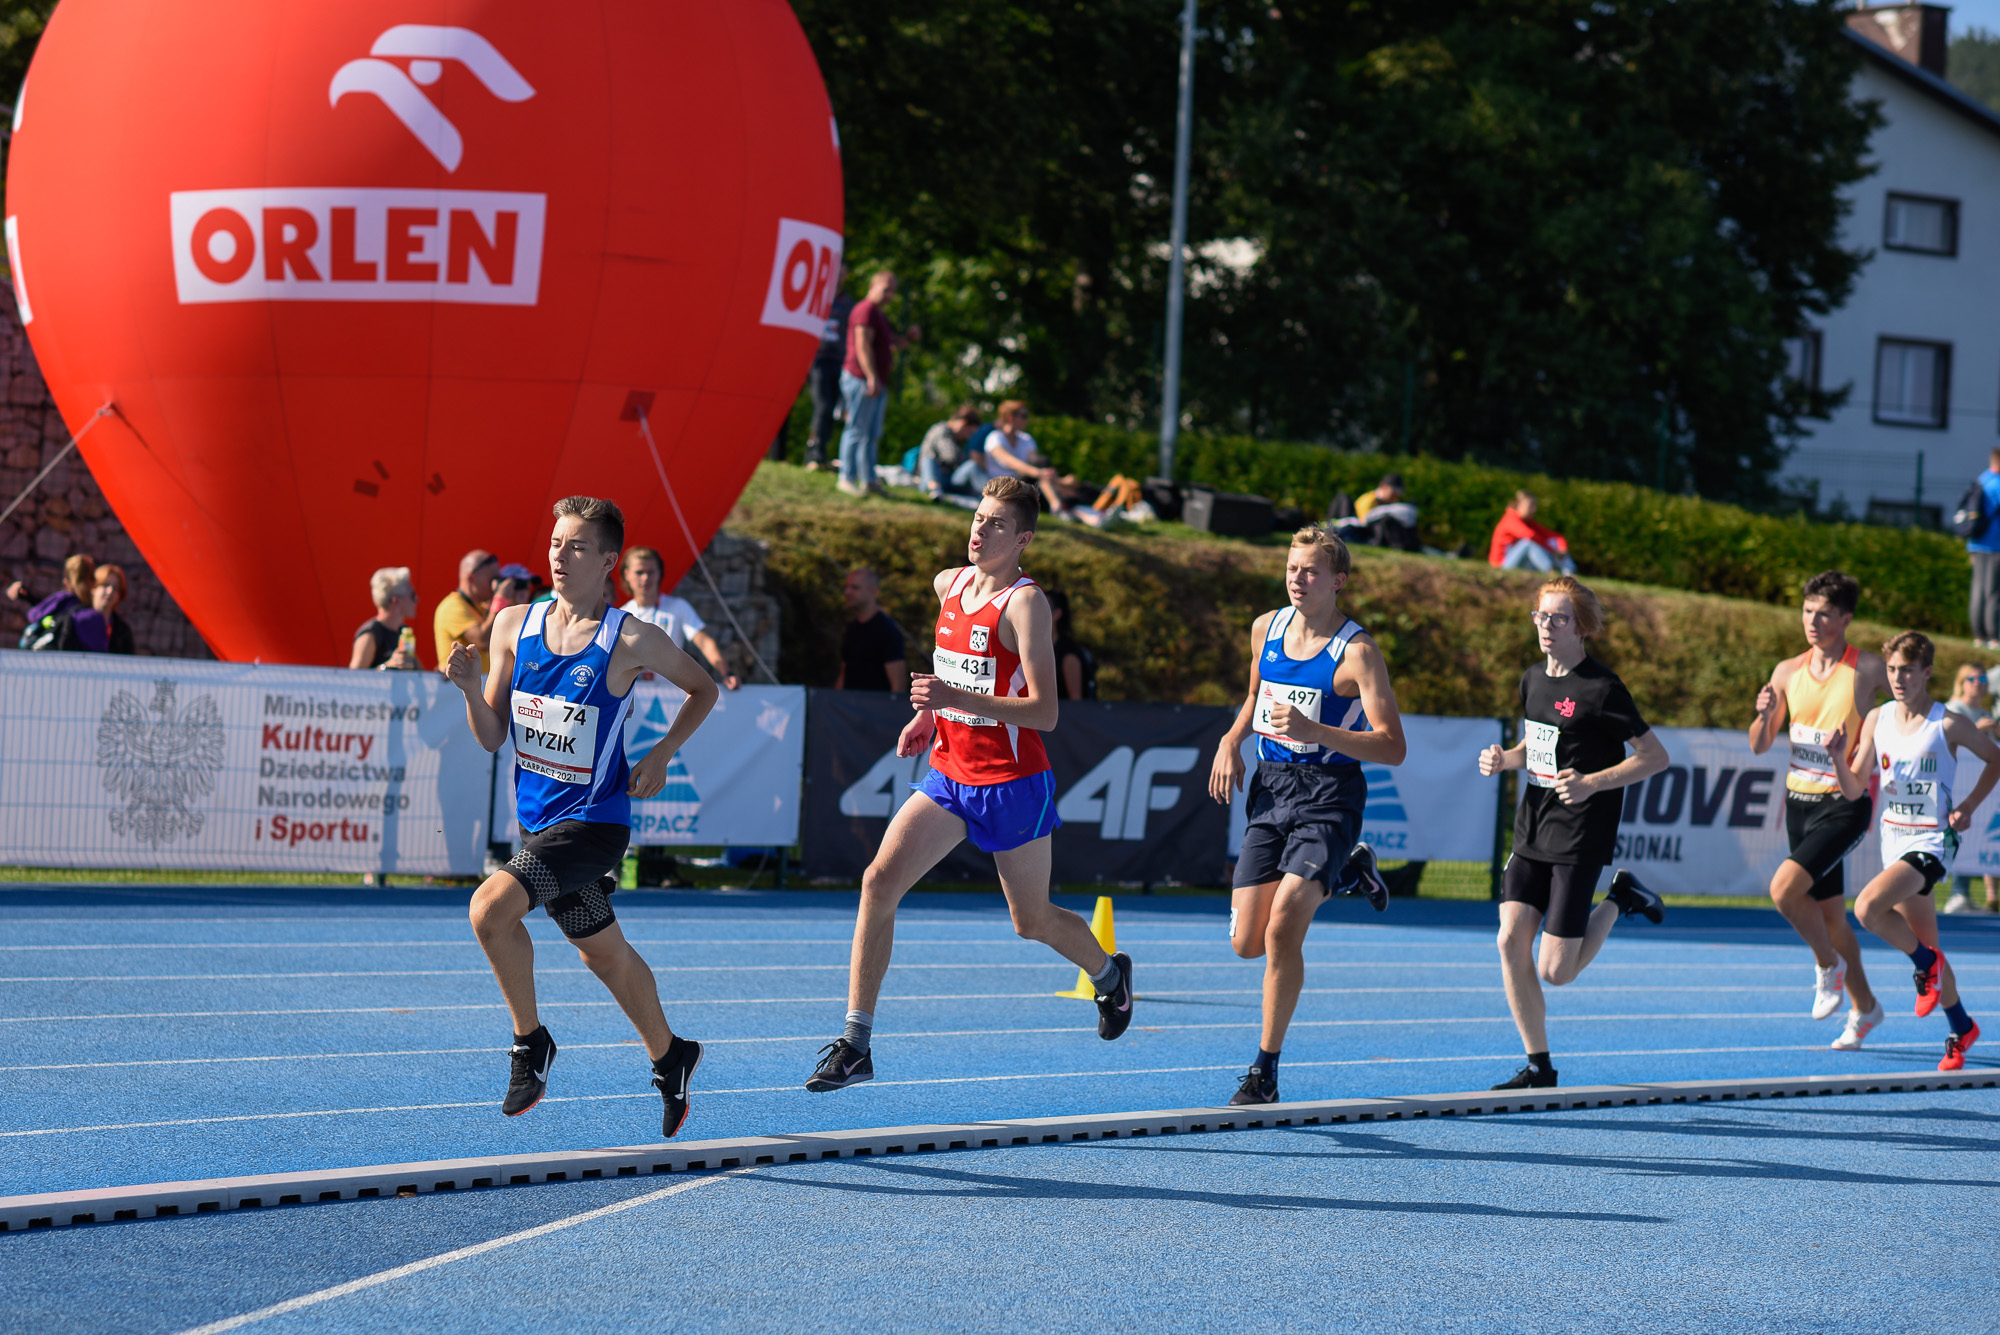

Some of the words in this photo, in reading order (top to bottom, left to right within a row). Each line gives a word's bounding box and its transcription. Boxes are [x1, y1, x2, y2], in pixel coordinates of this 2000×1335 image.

[190, 206, 519, 286] ORLEN
[961, 658, 991, 677] 431
[264, 694, 421, 721] Ministerstwo
[1287, 690, 1317, 706] 497
[519, 707, 543, 719] ORLEN
[563, 706, 587, 726] 74
[967, 716, 985, 725] 2021
[262, 724, 374, 760] Kultury
[525, 727, 577, 755] PYZIK
[1537, 727, 1555, 742] 217
[260, 757, 406, 782] Dziedzictwa
[521, 760, 555, 777] KARPACZ
[557, 772, 577, 782] 2021
[1057, 745, 1200, 840] 4F
[1906, 783, 1932, 795] 127
[258, 786, 410, 815] Narodowego
[1889, 801, 1925, 816] REETZ
[256, 818, 262, 840] i
[631, 815, 699, 833] RPACZ
[1362, 831, 1407, 850] PACZ
[1613, 835, 1682, 862] SIONAL
